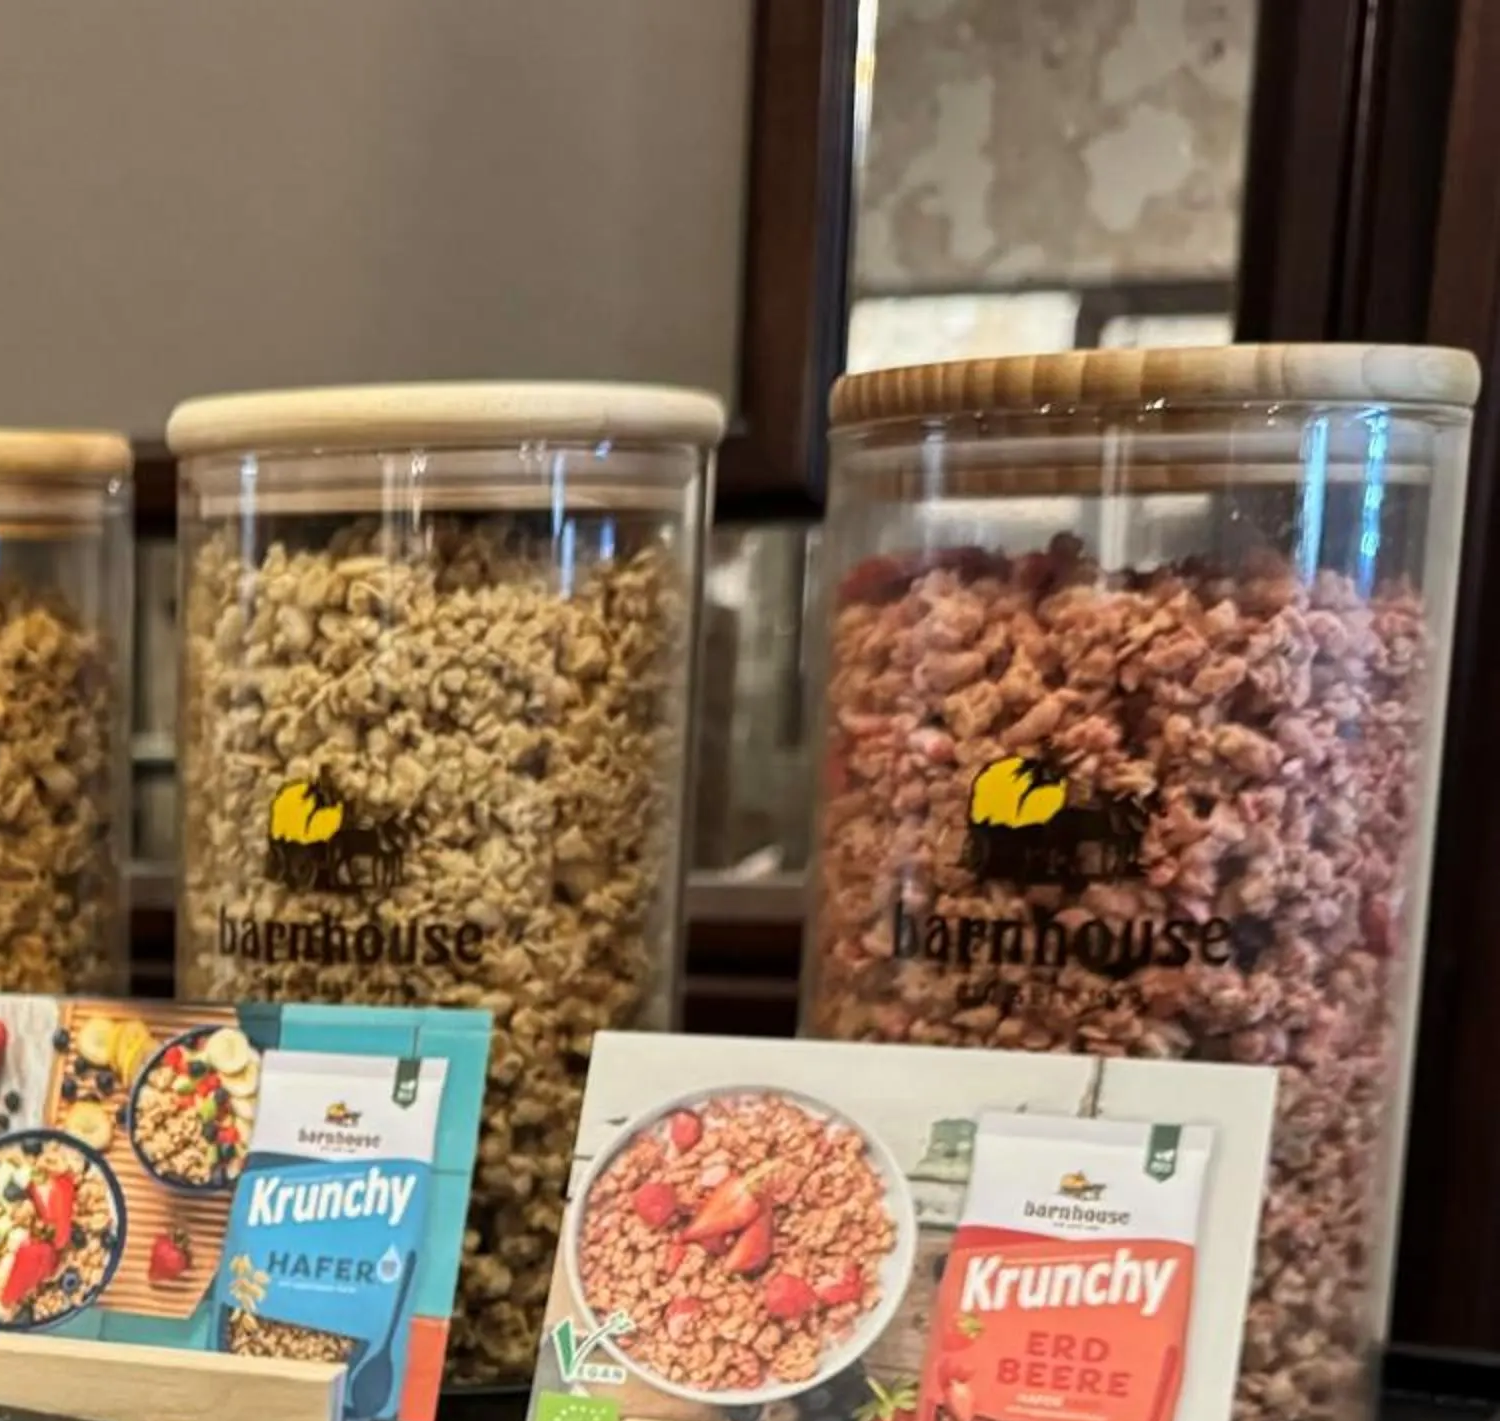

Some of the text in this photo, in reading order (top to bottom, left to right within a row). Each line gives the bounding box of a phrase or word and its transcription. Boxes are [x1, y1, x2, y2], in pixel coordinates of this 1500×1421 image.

[217, 903, 485, 966] barnhouse
[893, 886, 1233, 970] barnhouse
[297, 1126, 381, 1149] barnhouse
[247, 1166, 417, 1227] Krunchy
[1023, 1200, 1132, 1226] barnhouse
[267, 1250, 376, 1285] HAFER
[960, 1248, 1179, 1318] Krunchy
[1026, 1329, 1111, 1364] ERD
[994, 1356, 1133, 1399] BEERE
